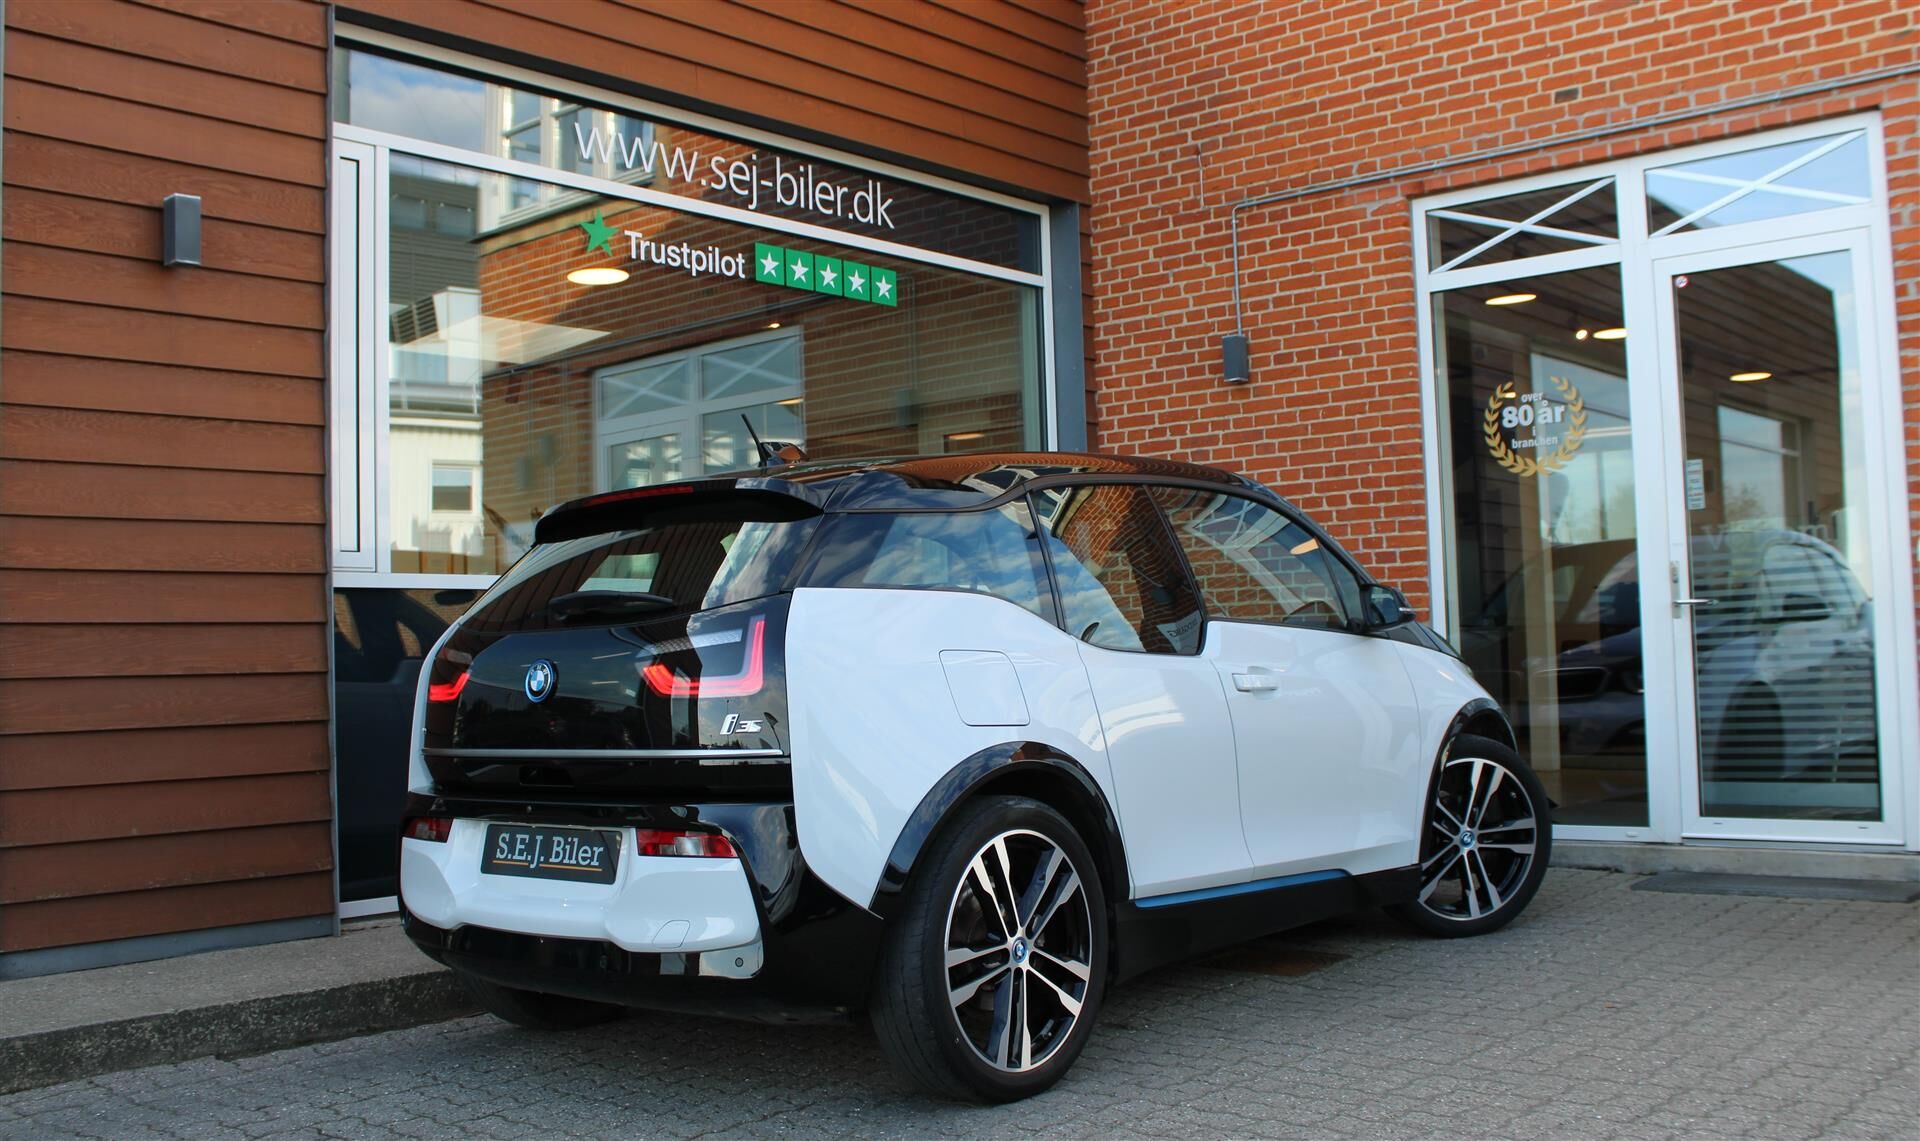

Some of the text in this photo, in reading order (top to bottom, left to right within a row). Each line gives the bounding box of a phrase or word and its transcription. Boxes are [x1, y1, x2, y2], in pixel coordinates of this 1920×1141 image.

[574, 121, 895, 229] www.sej-biler.dk
[624, 230, 746, 279] Trustpilot
[1502, 399, 1566, 429] 80 år
[1521, 392, 1544, 403] over
[496, 832, 604, 869] S.E.J. Biler
